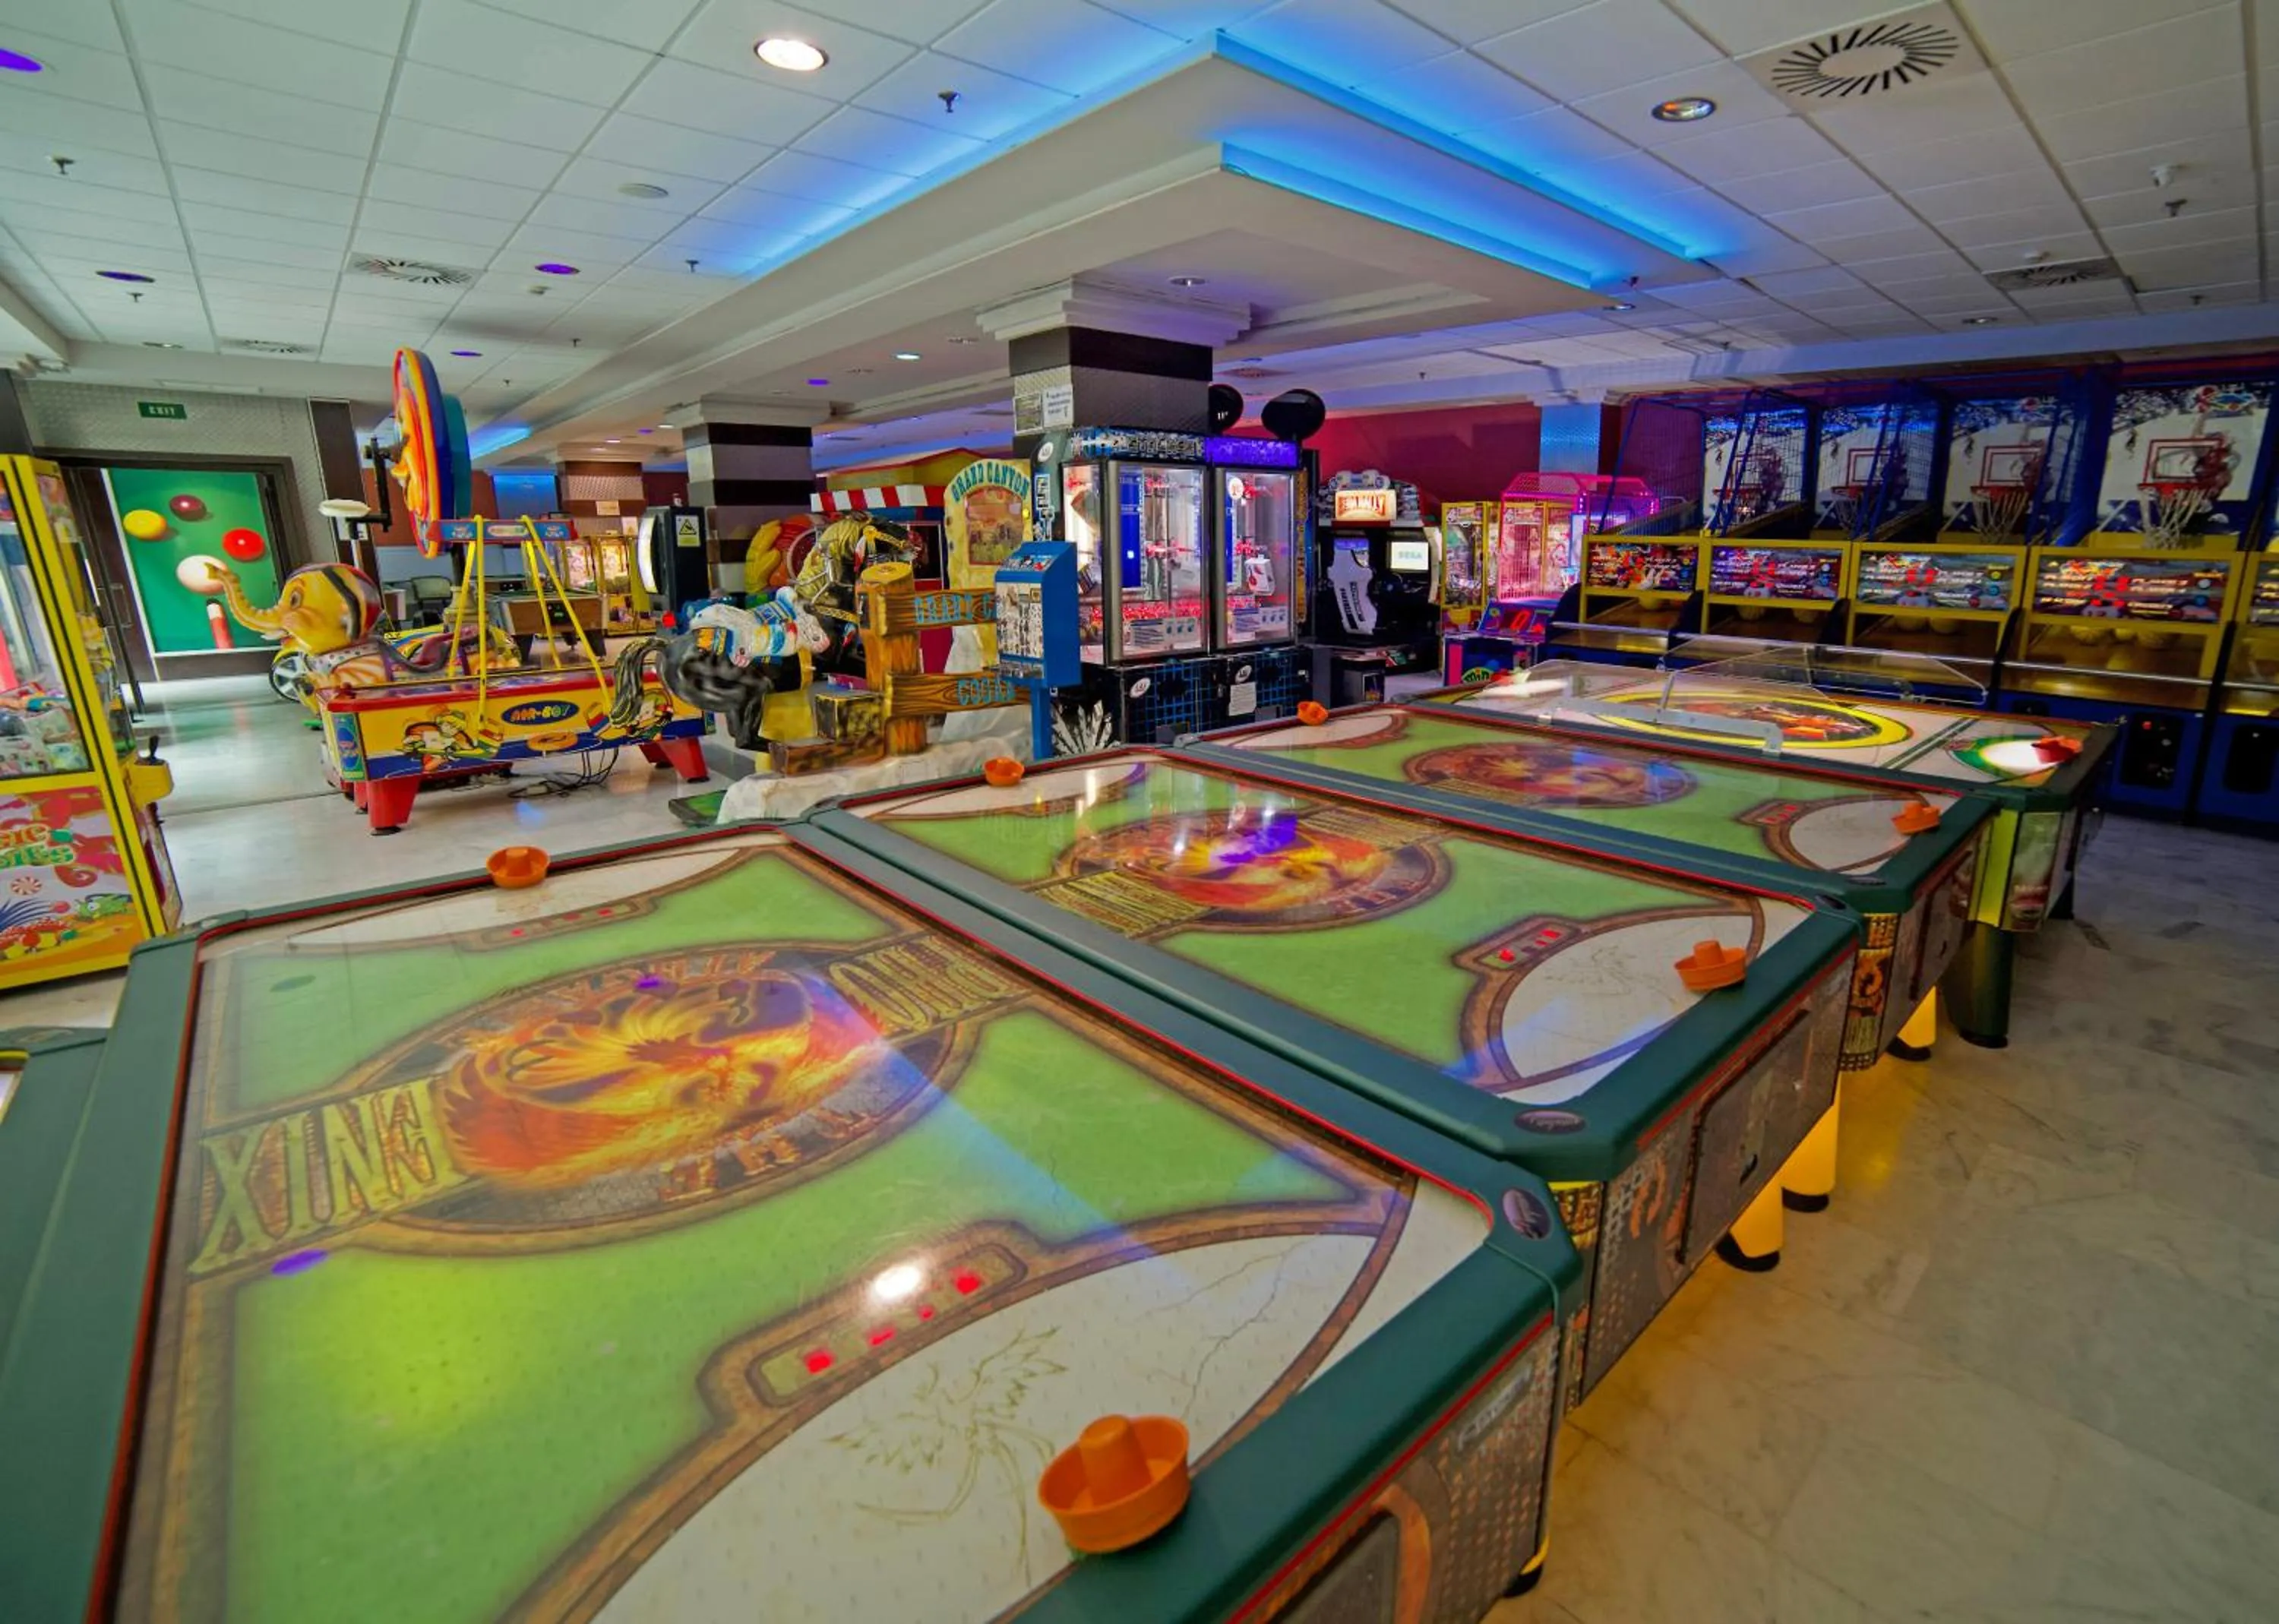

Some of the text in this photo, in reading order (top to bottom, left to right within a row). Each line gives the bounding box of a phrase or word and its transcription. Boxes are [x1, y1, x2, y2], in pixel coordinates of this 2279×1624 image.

[149, 406, 175, 416] EXIT
[951, 461, 1029, 502] GRAND CANYON
